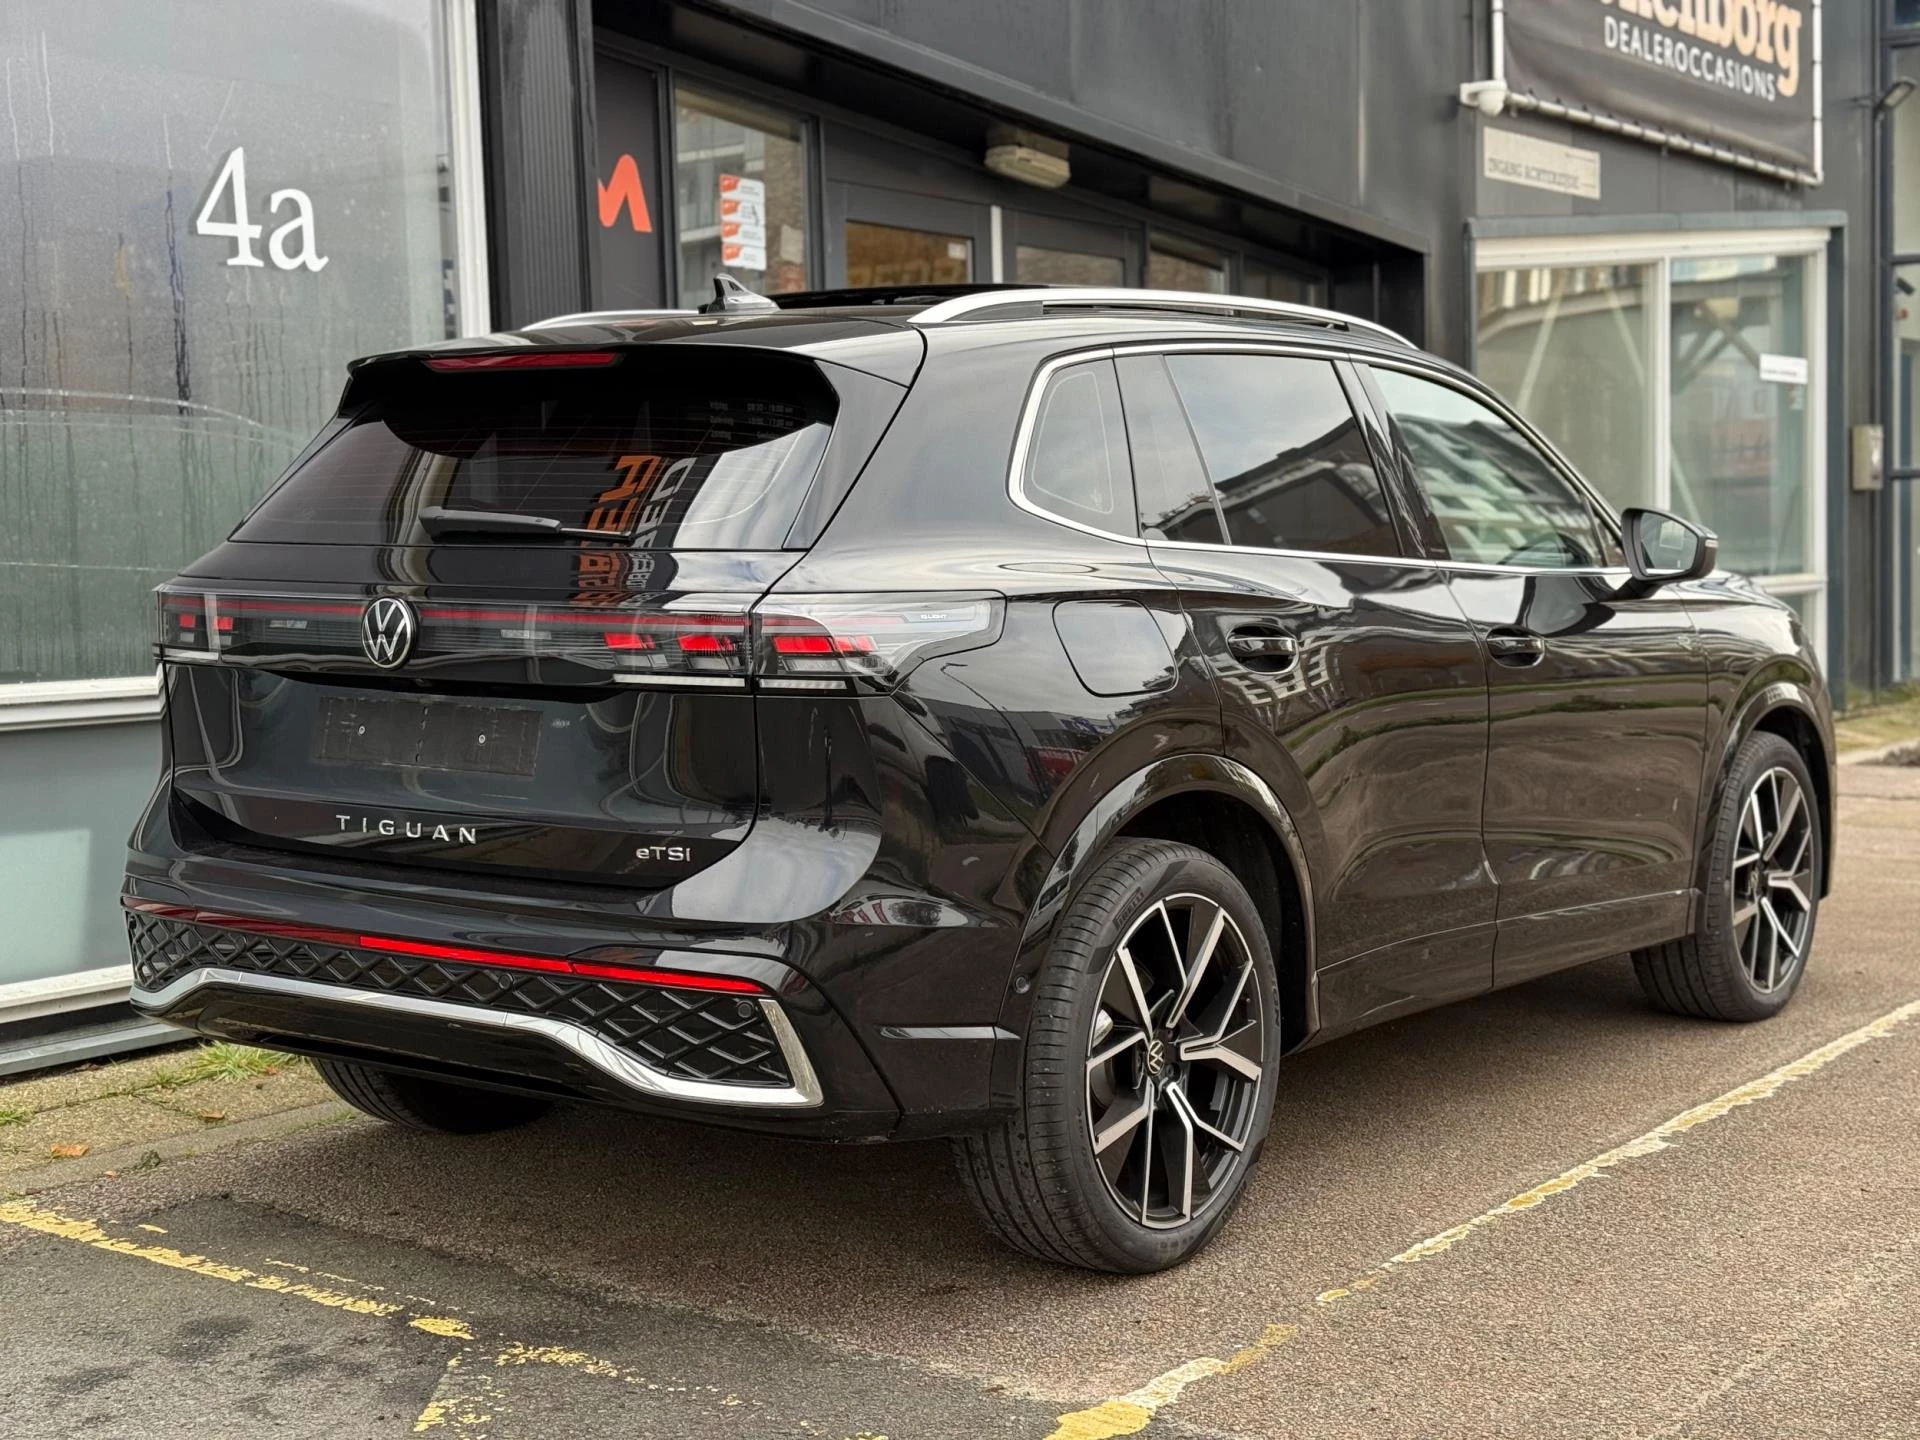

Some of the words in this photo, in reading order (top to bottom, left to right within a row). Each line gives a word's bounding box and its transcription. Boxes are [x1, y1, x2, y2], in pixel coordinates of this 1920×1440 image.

[1604, 16, 1776, 101] DEALEROCCASIONS
[196, 146, 329, 273] 4a
[335, 814, 477, 845] TIGUAN
[635, 845, 691, 862] eTSI
